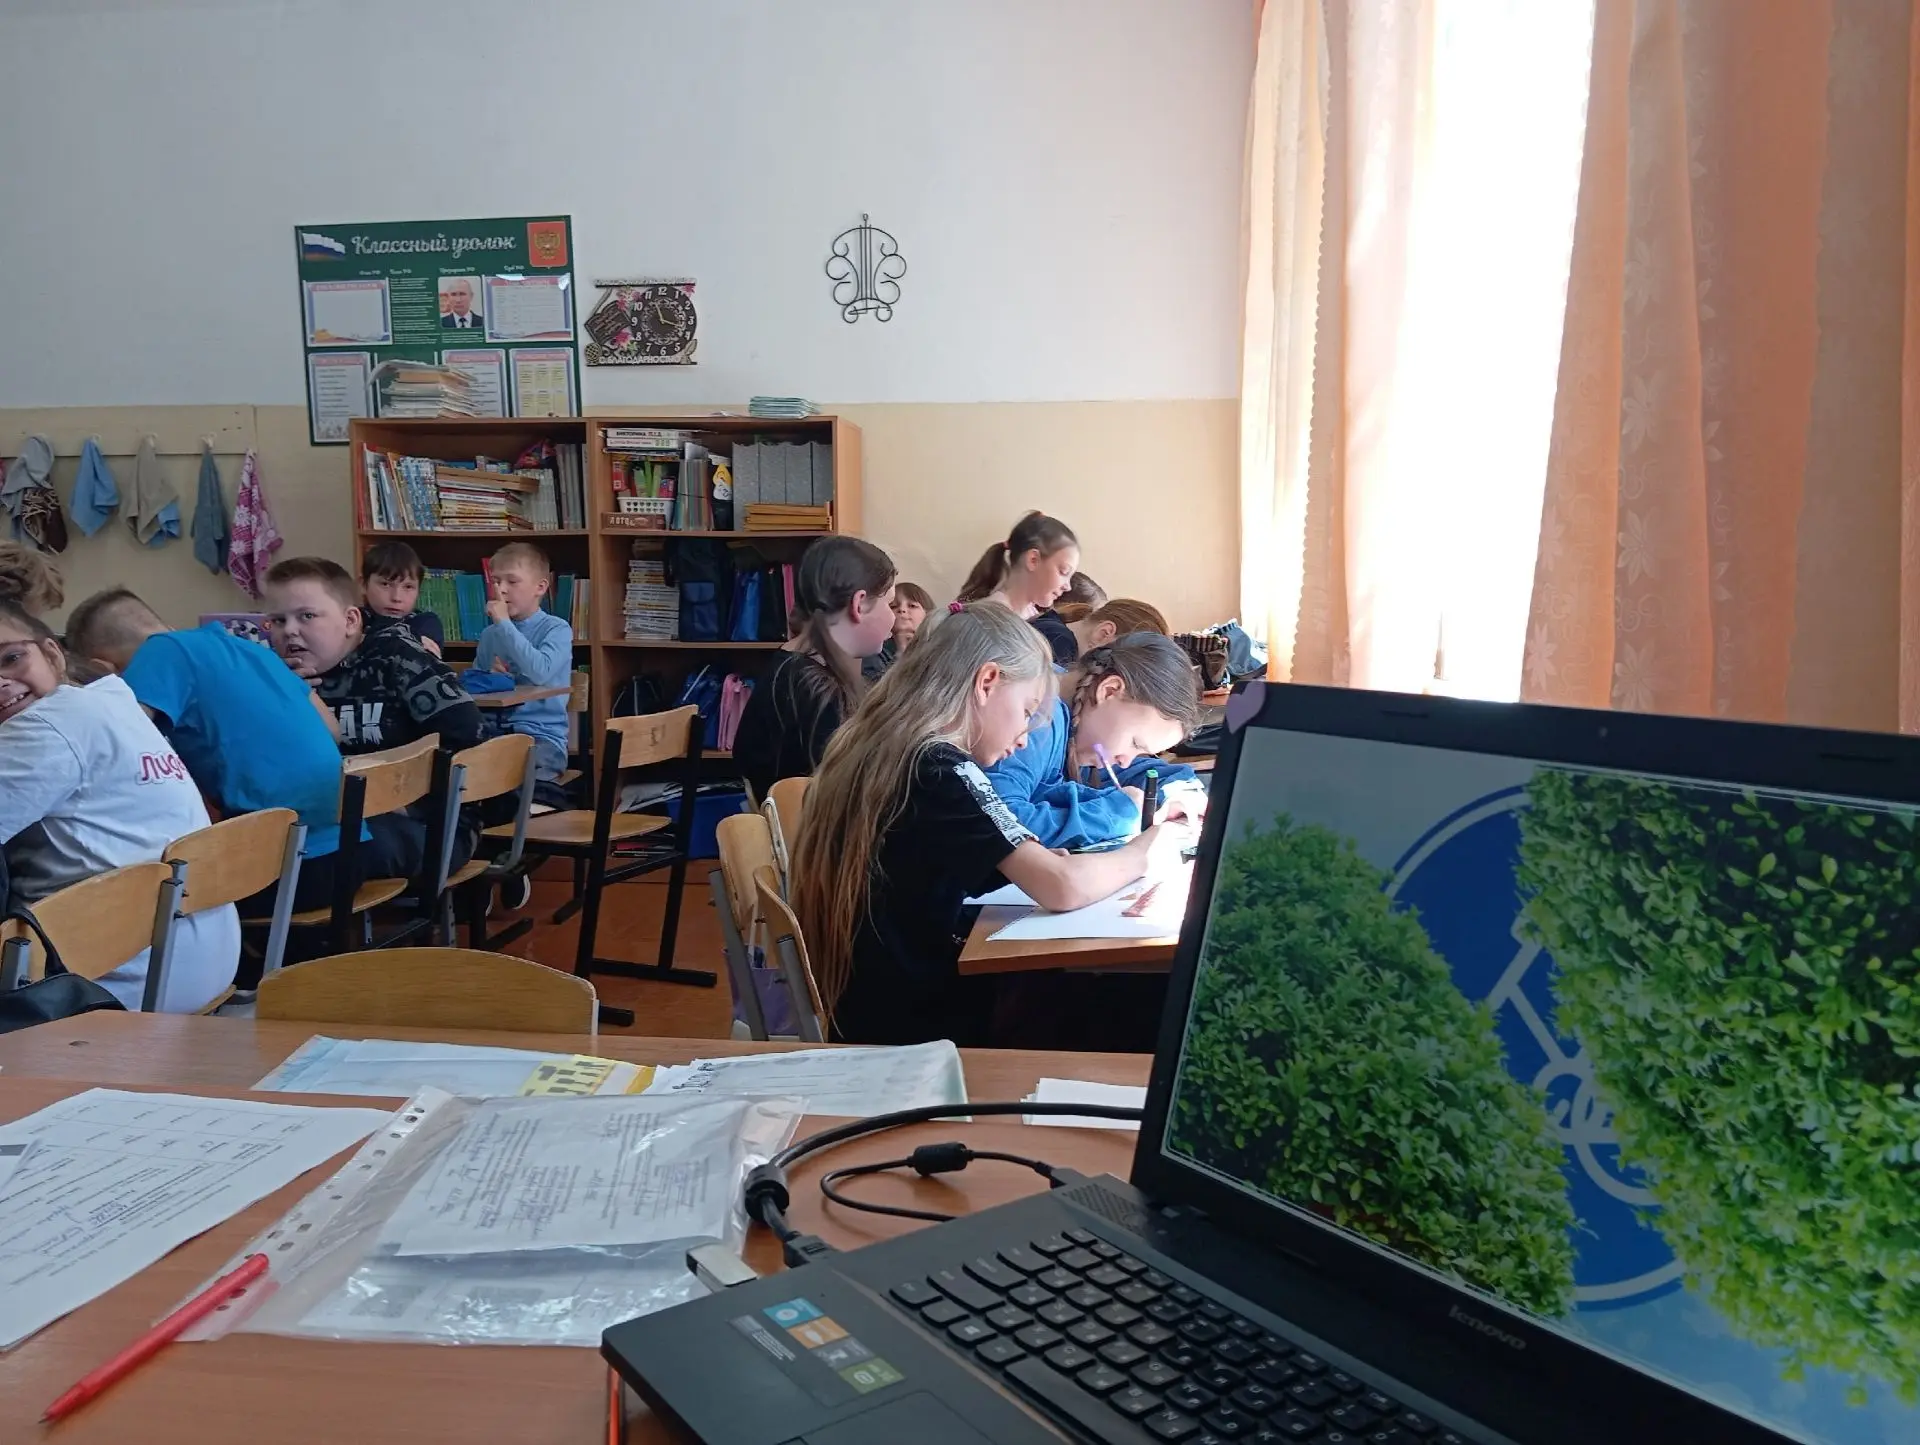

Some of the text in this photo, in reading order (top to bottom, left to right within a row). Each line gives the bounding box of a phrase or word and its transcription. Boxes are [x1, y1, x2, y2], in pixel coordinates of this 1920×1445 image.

[351, 233, 517, 259] Классный уголок
[645, 291, 653, 300] 11
[658, 286, 667, 296] 12
[633, 301, 643, 311] 10
[684, 301, 691, 310] 2
[631, 317, 638, 326] 9
[687, 317, 694, 325] 3
[635, 332, 642, 341] 8
[684, 331, 691, 340] 4
[645, 343, 652, 352] 7
[660, 346, 667, 355] 6
[674, 343, 680, 352] 5
[1448, 1304, 1527, 1351] lenovo
